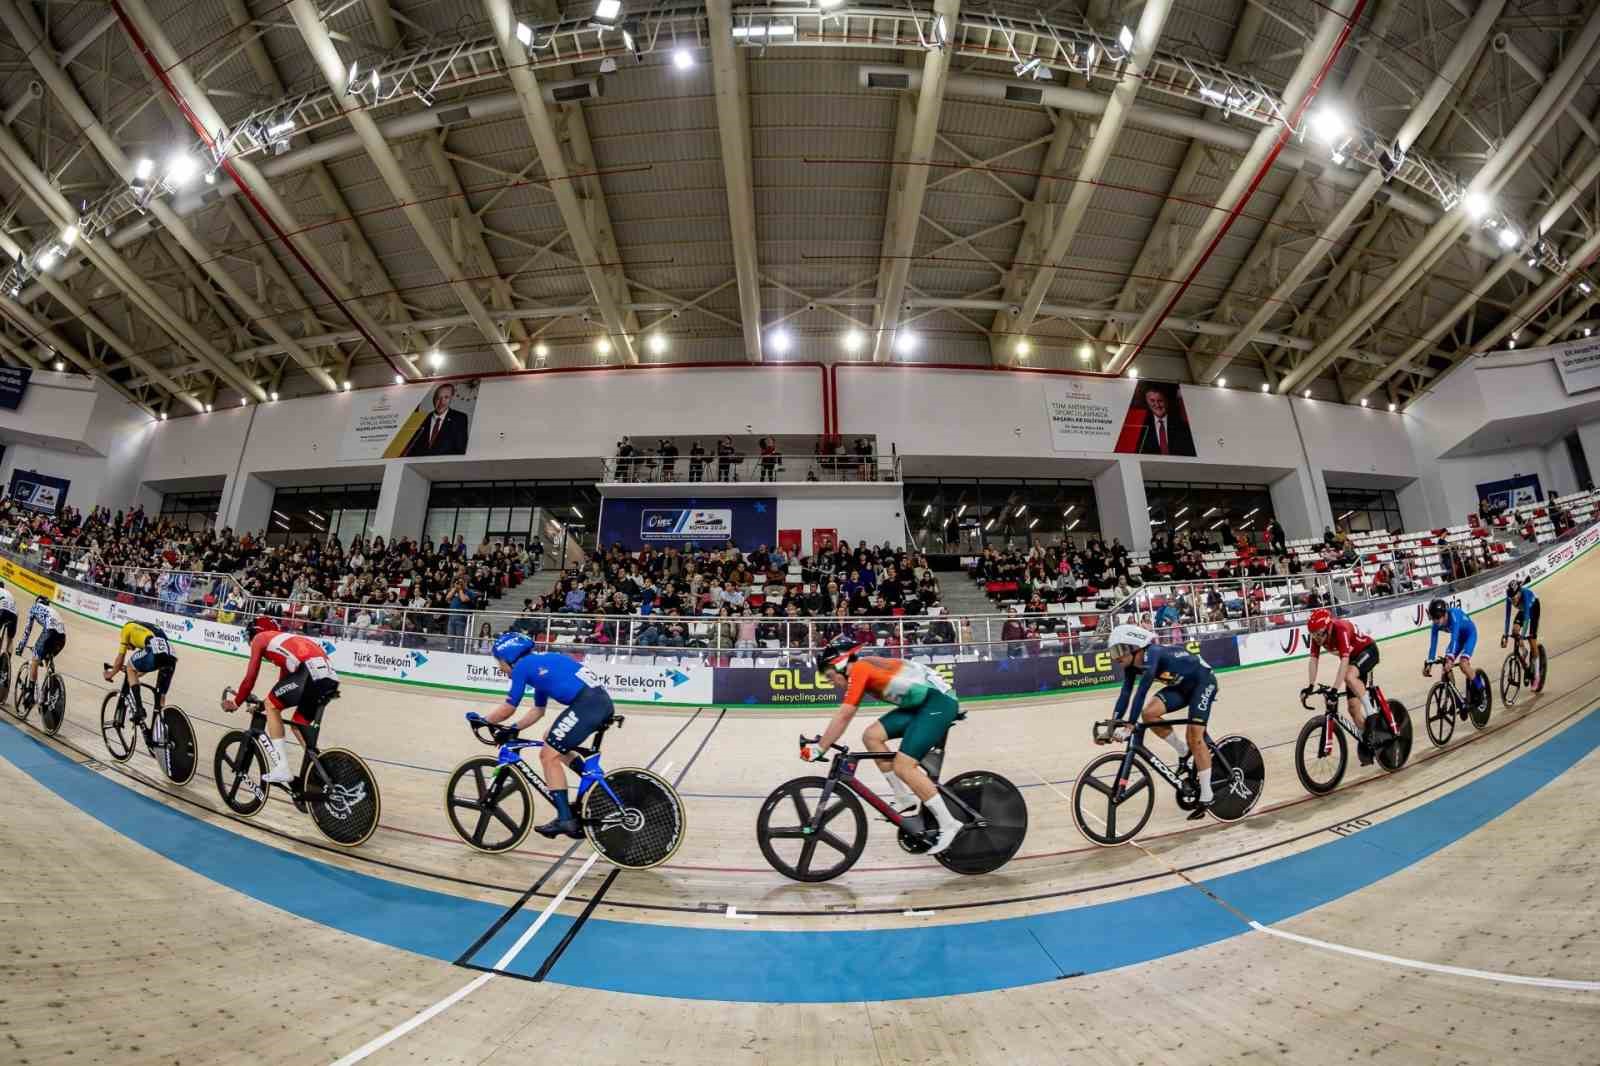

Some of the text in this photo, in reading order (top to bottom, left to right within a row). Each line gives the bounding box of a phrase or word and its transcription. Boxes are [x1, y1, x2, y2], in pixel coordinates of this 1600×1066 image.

[217, 630, 241, 642] Telekom
[354, 651, 372, 663] Türk
[374, 653, 411, 668] Telekom
[466, 663, 489, 676] Türk
[615, 674, 666, 688] Telekom
[771, 692, 837, 704] alecycling.com
[1150, 756, 1183, 789] KOGA
